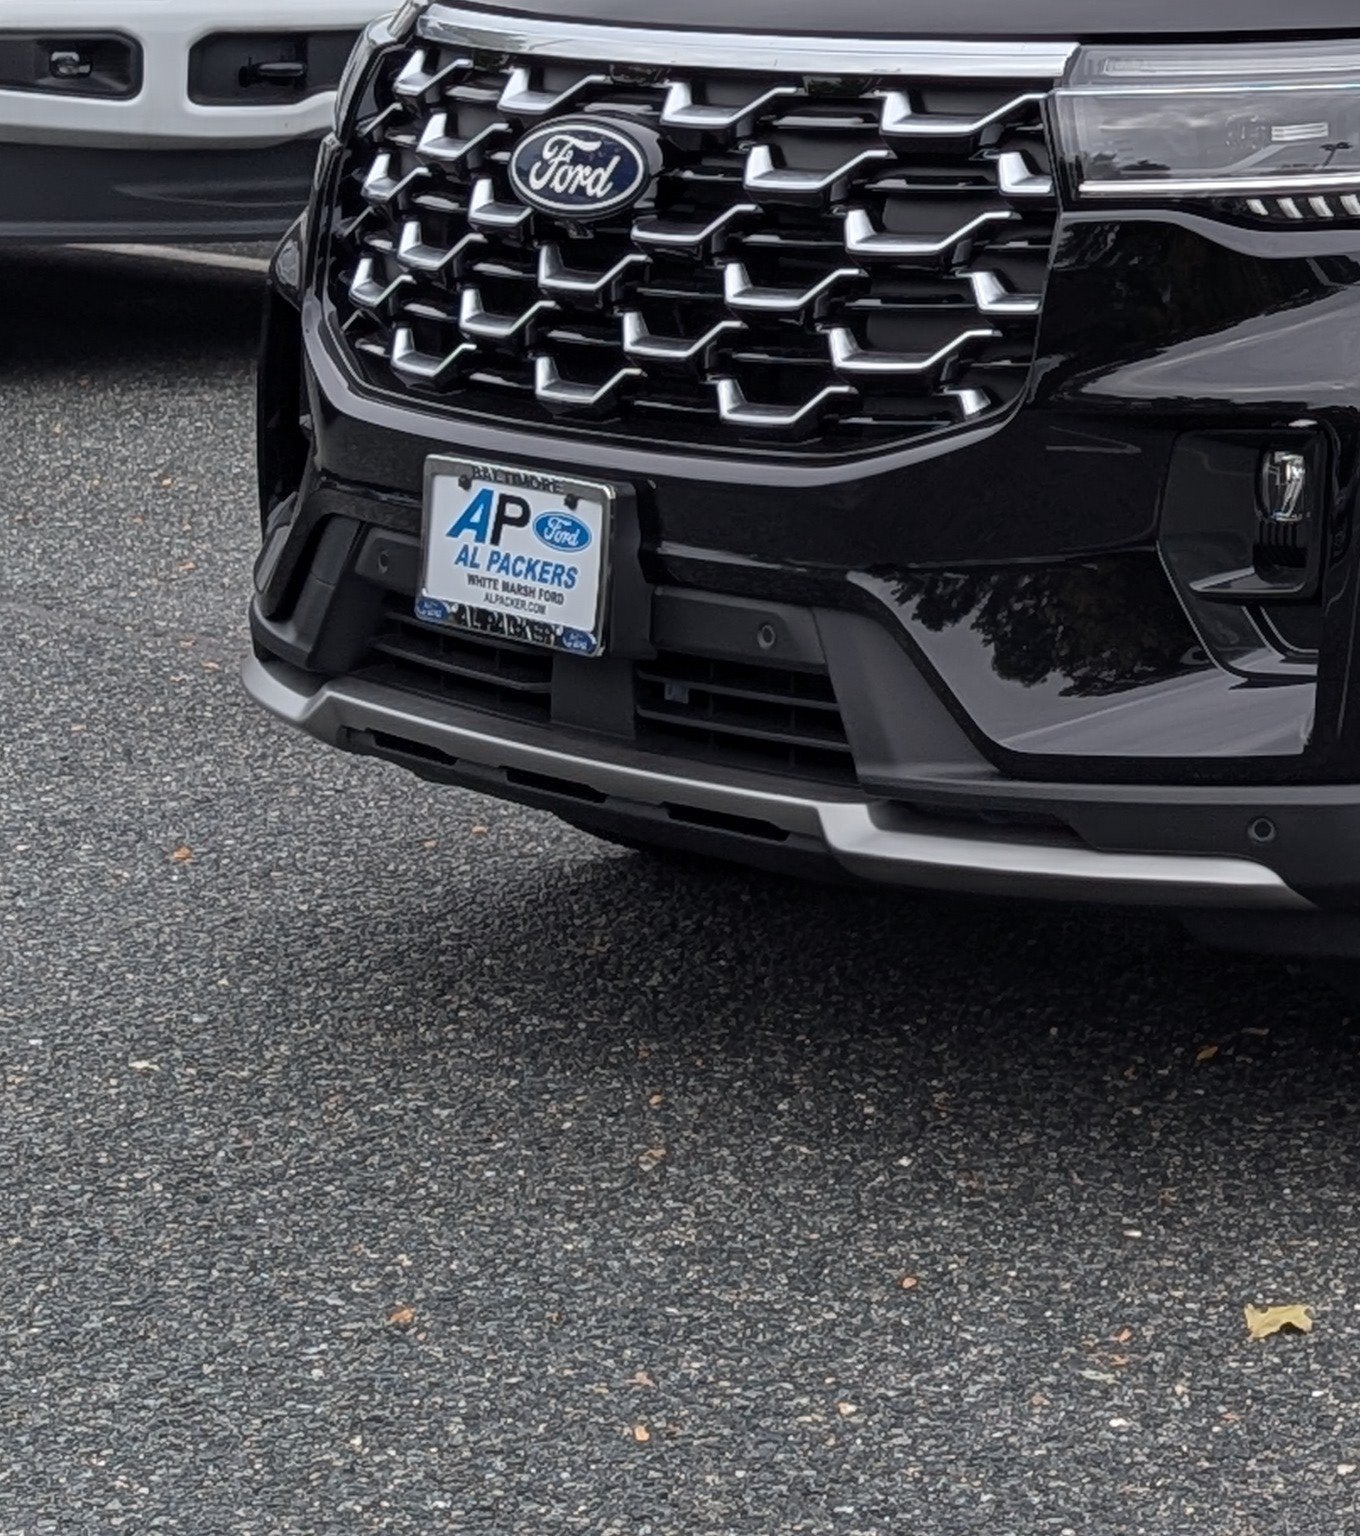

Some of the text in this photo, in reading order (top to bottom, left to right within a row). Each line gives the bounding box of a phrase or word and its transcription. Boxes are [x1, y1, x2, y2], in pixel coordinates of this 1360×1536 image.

[529, 134, 621, 198] Ford
[472, 465, 565, 494] BALTIMORE
[446, 488, 532, 546] AP
[543, 516, 581, 546] Ford
[454, 544, 578, 589] AL PACKERS
[467, 573, 565, 605] WHITE MARSH FORD
